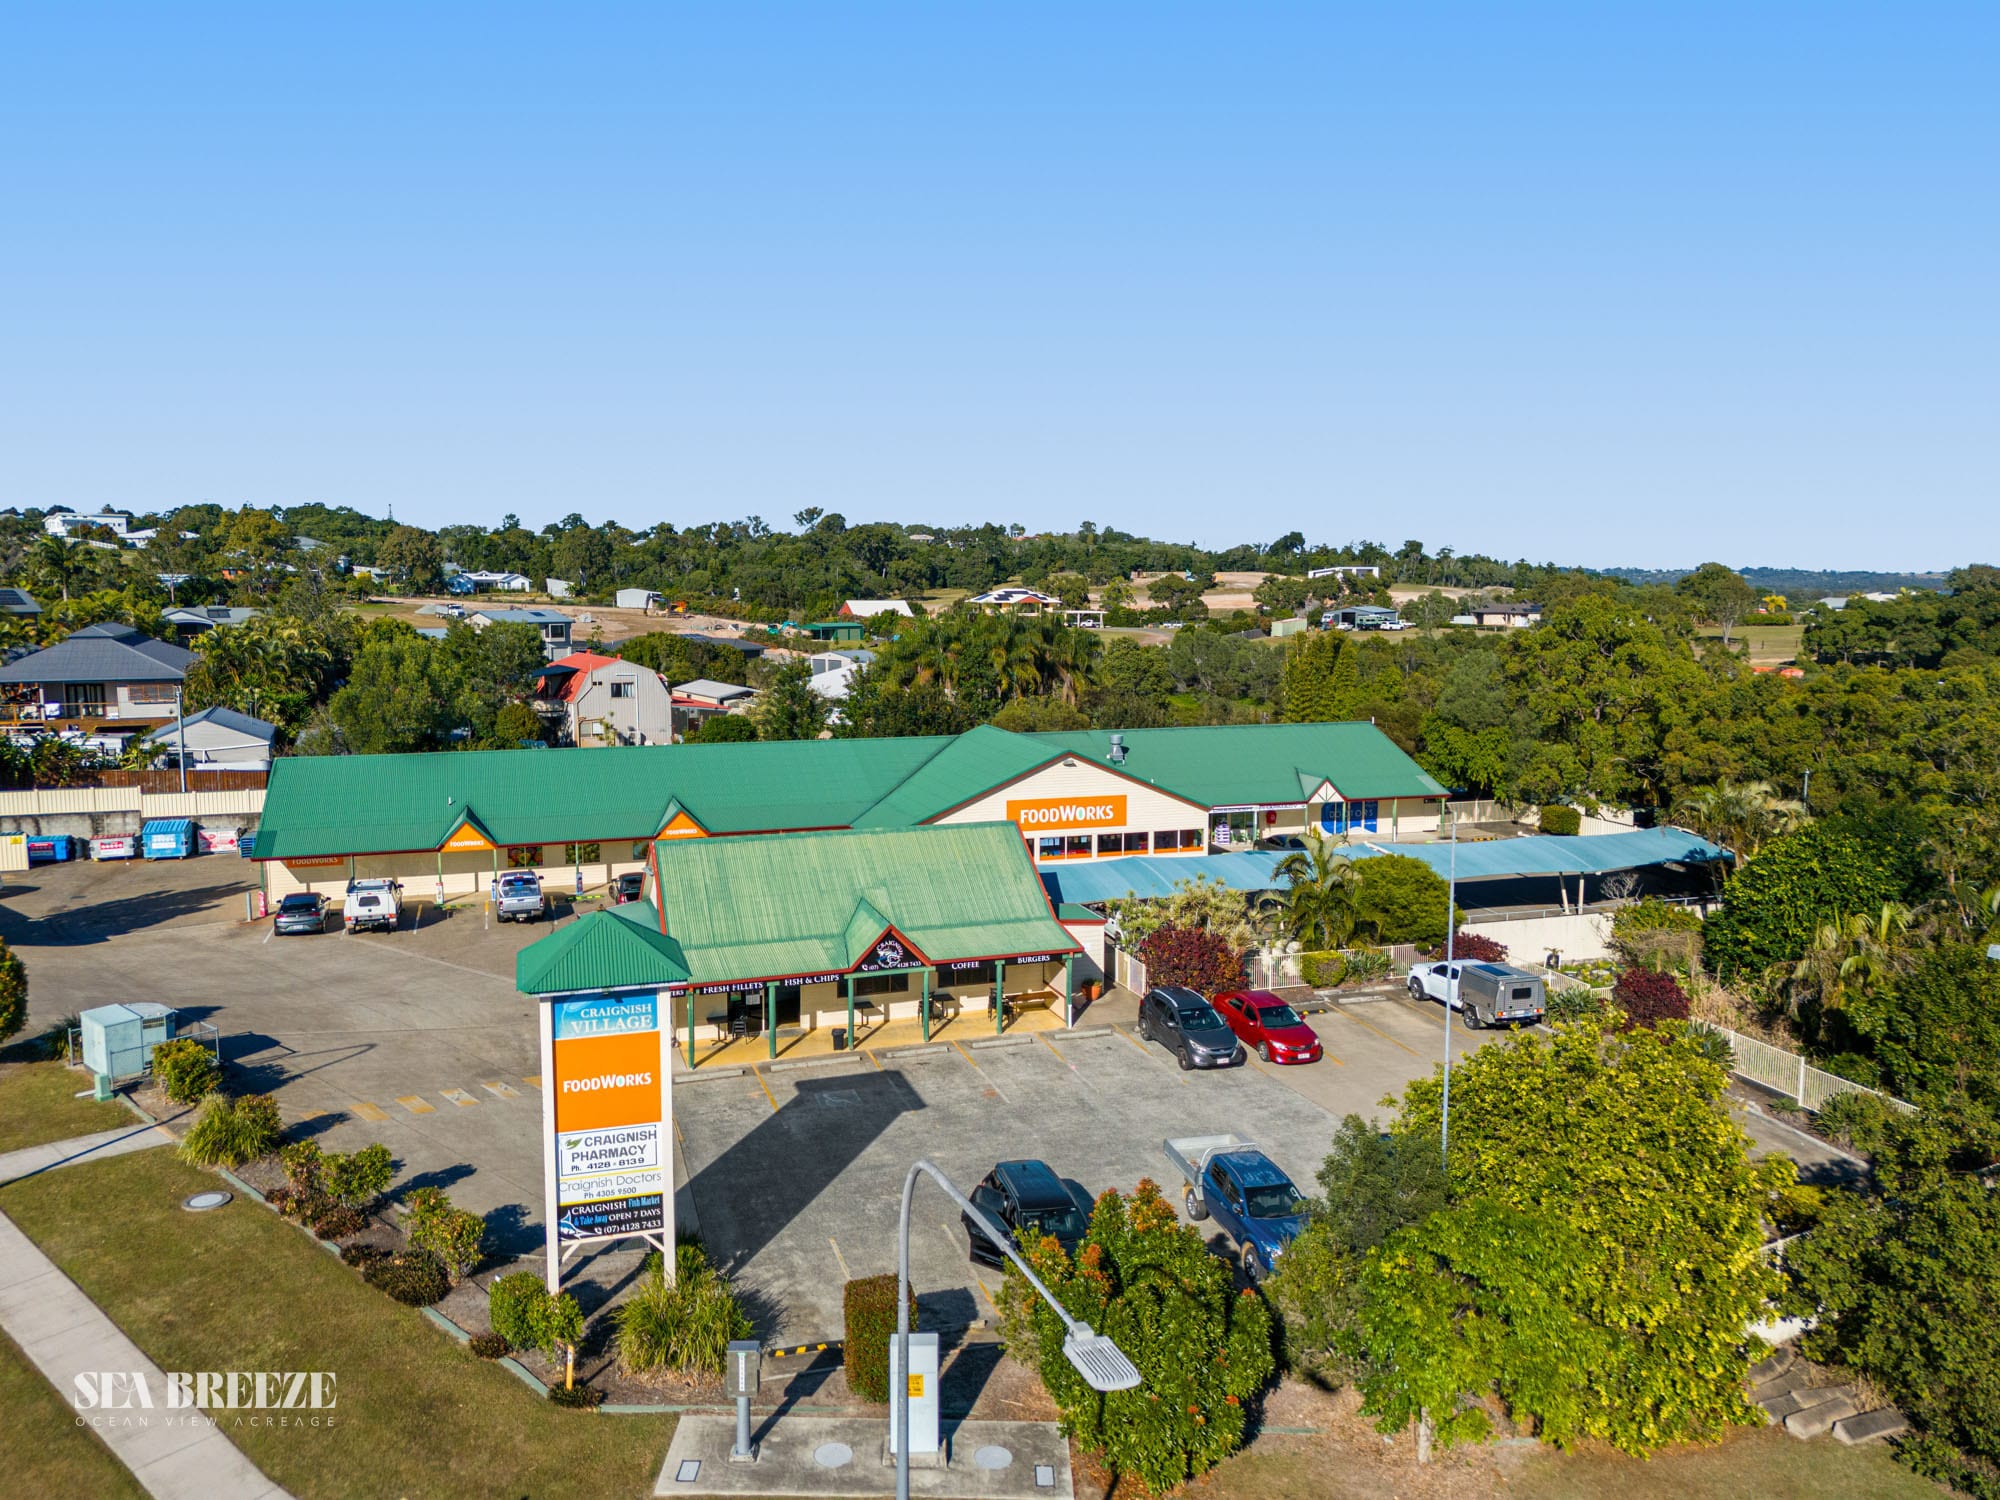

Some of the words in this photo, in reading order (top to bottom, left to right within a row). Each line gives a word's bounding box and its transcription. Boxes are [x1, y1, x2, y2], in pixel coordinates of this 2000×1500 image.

[1020, 804, 1114, 824] FOODWORKS
[1329, 809, 1374, 818] DOTORS
[666, 828, 698, 836] FOODWORKS
[450, 840, 484, 848] FOODWORKS
[951, 961, 980, 970] COFFEE
[1017, 955, 1051, 964] BURGERS
[703, 985, 730, 994] FRESH
[732, 982, 764, 992] FILLETS
[784, 977, 804, 987] FISH
[805, 977, 813, 985] &
[814, 974, 840, 983] CHIPS
[580, 1003, 652, 1018] CRAIGNISH
[570, 1014, 653, 1034] VILLAGE
[563, 1072, 652, 1093] FOODWORKS
[584, 1129, 657, 1147] CRAIGNISH
[571, 1144, 646, 1162] PHARMACY
[571, 1164, 581, 1172] Ph.
[587, 1161, 611, 1169] 4128
[618, 1157, 645, 1166] 8139
[560, 1177, 612, 1192] Craignish
[616, 1173, 661, 1186] Doctors
[584, 1191, 594, 1199] Ph
[596, 1189, 615, 1197] 4305
[617, 1186, 637, 1194] 9500
[571, 1200, 627, 1215] CRAIGNISH
[608, 1212, 632, 1221] OPEN
[633, 1210, 639, 1218] 7
[640, 1208, 661, 1217] DAYS
[603, 1225, 620, 1234] (07)
[620, 1222, 640, 1231] 4128
[641, 1219, 661, 1229] 7433
